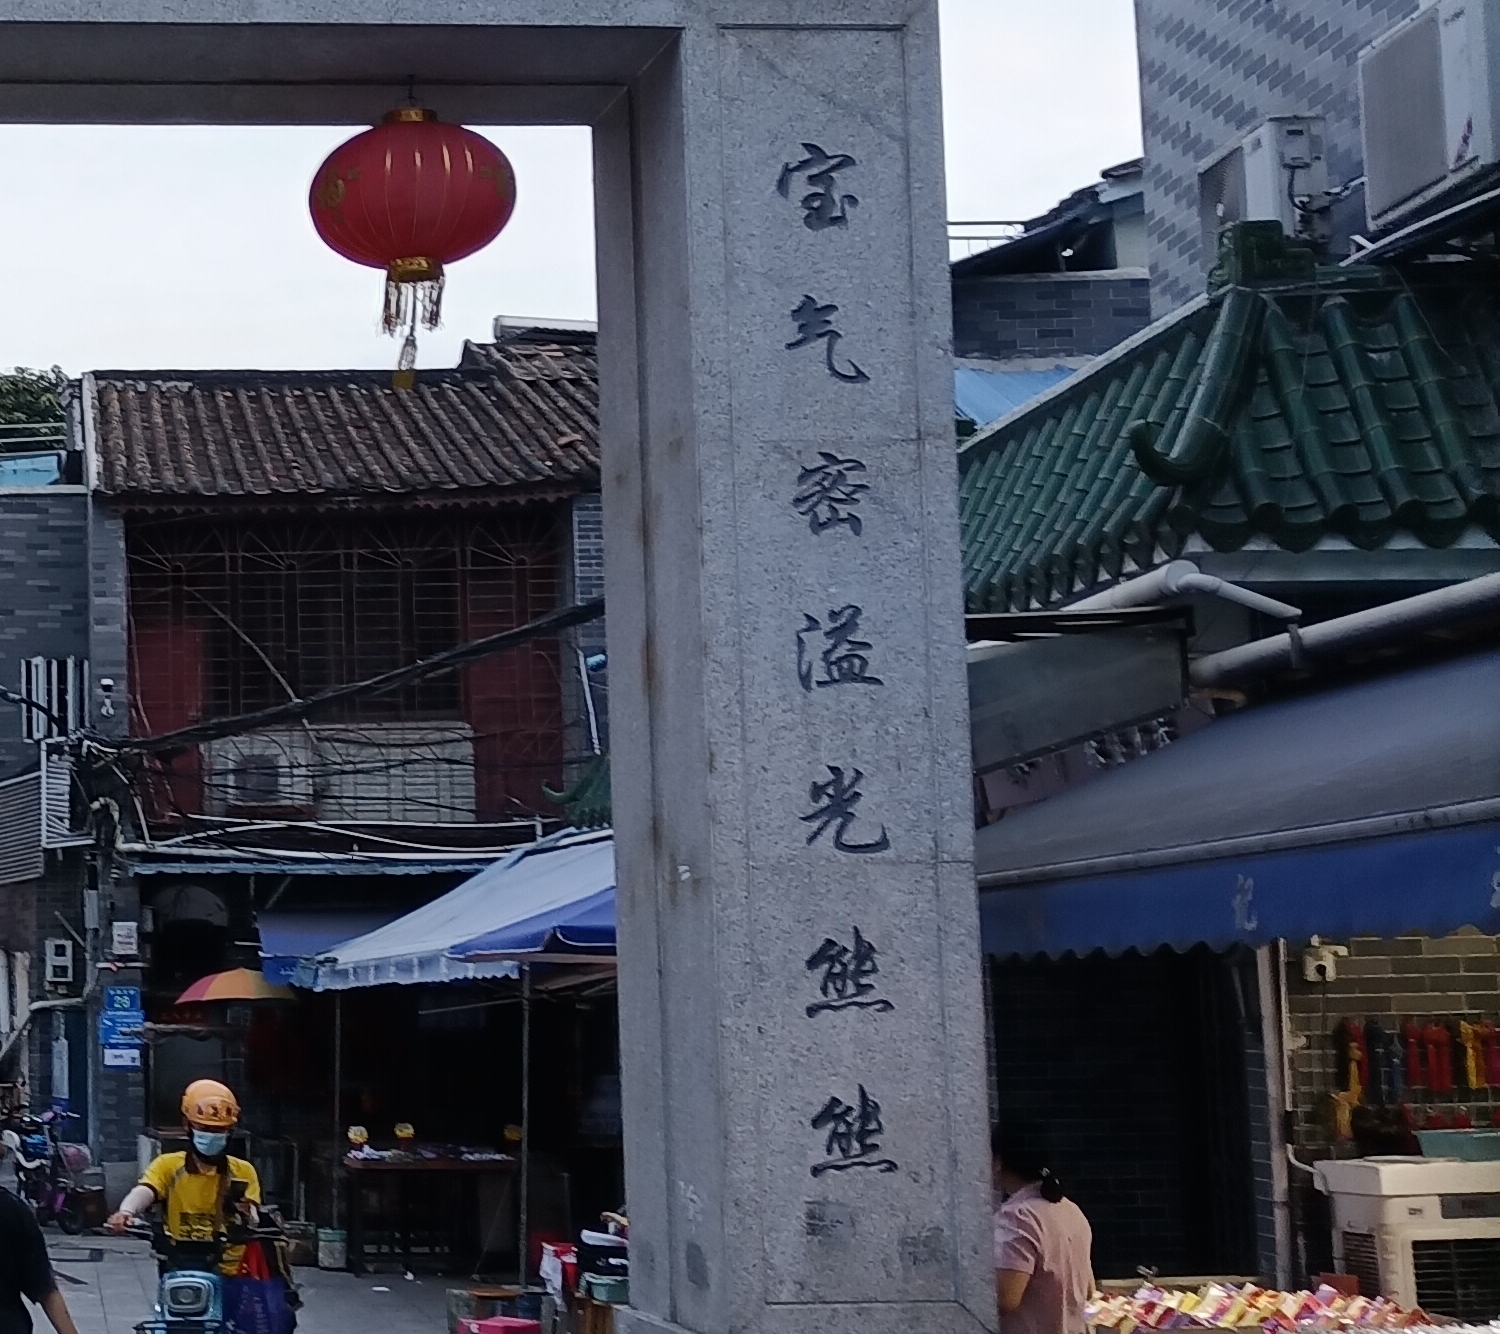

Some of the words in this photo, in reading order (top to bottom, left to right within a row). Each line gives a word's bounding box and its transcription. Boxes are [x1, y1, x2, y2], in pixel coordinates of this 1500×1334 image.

[775, 141, 899, 1178] 宝气密溢光熊熊
